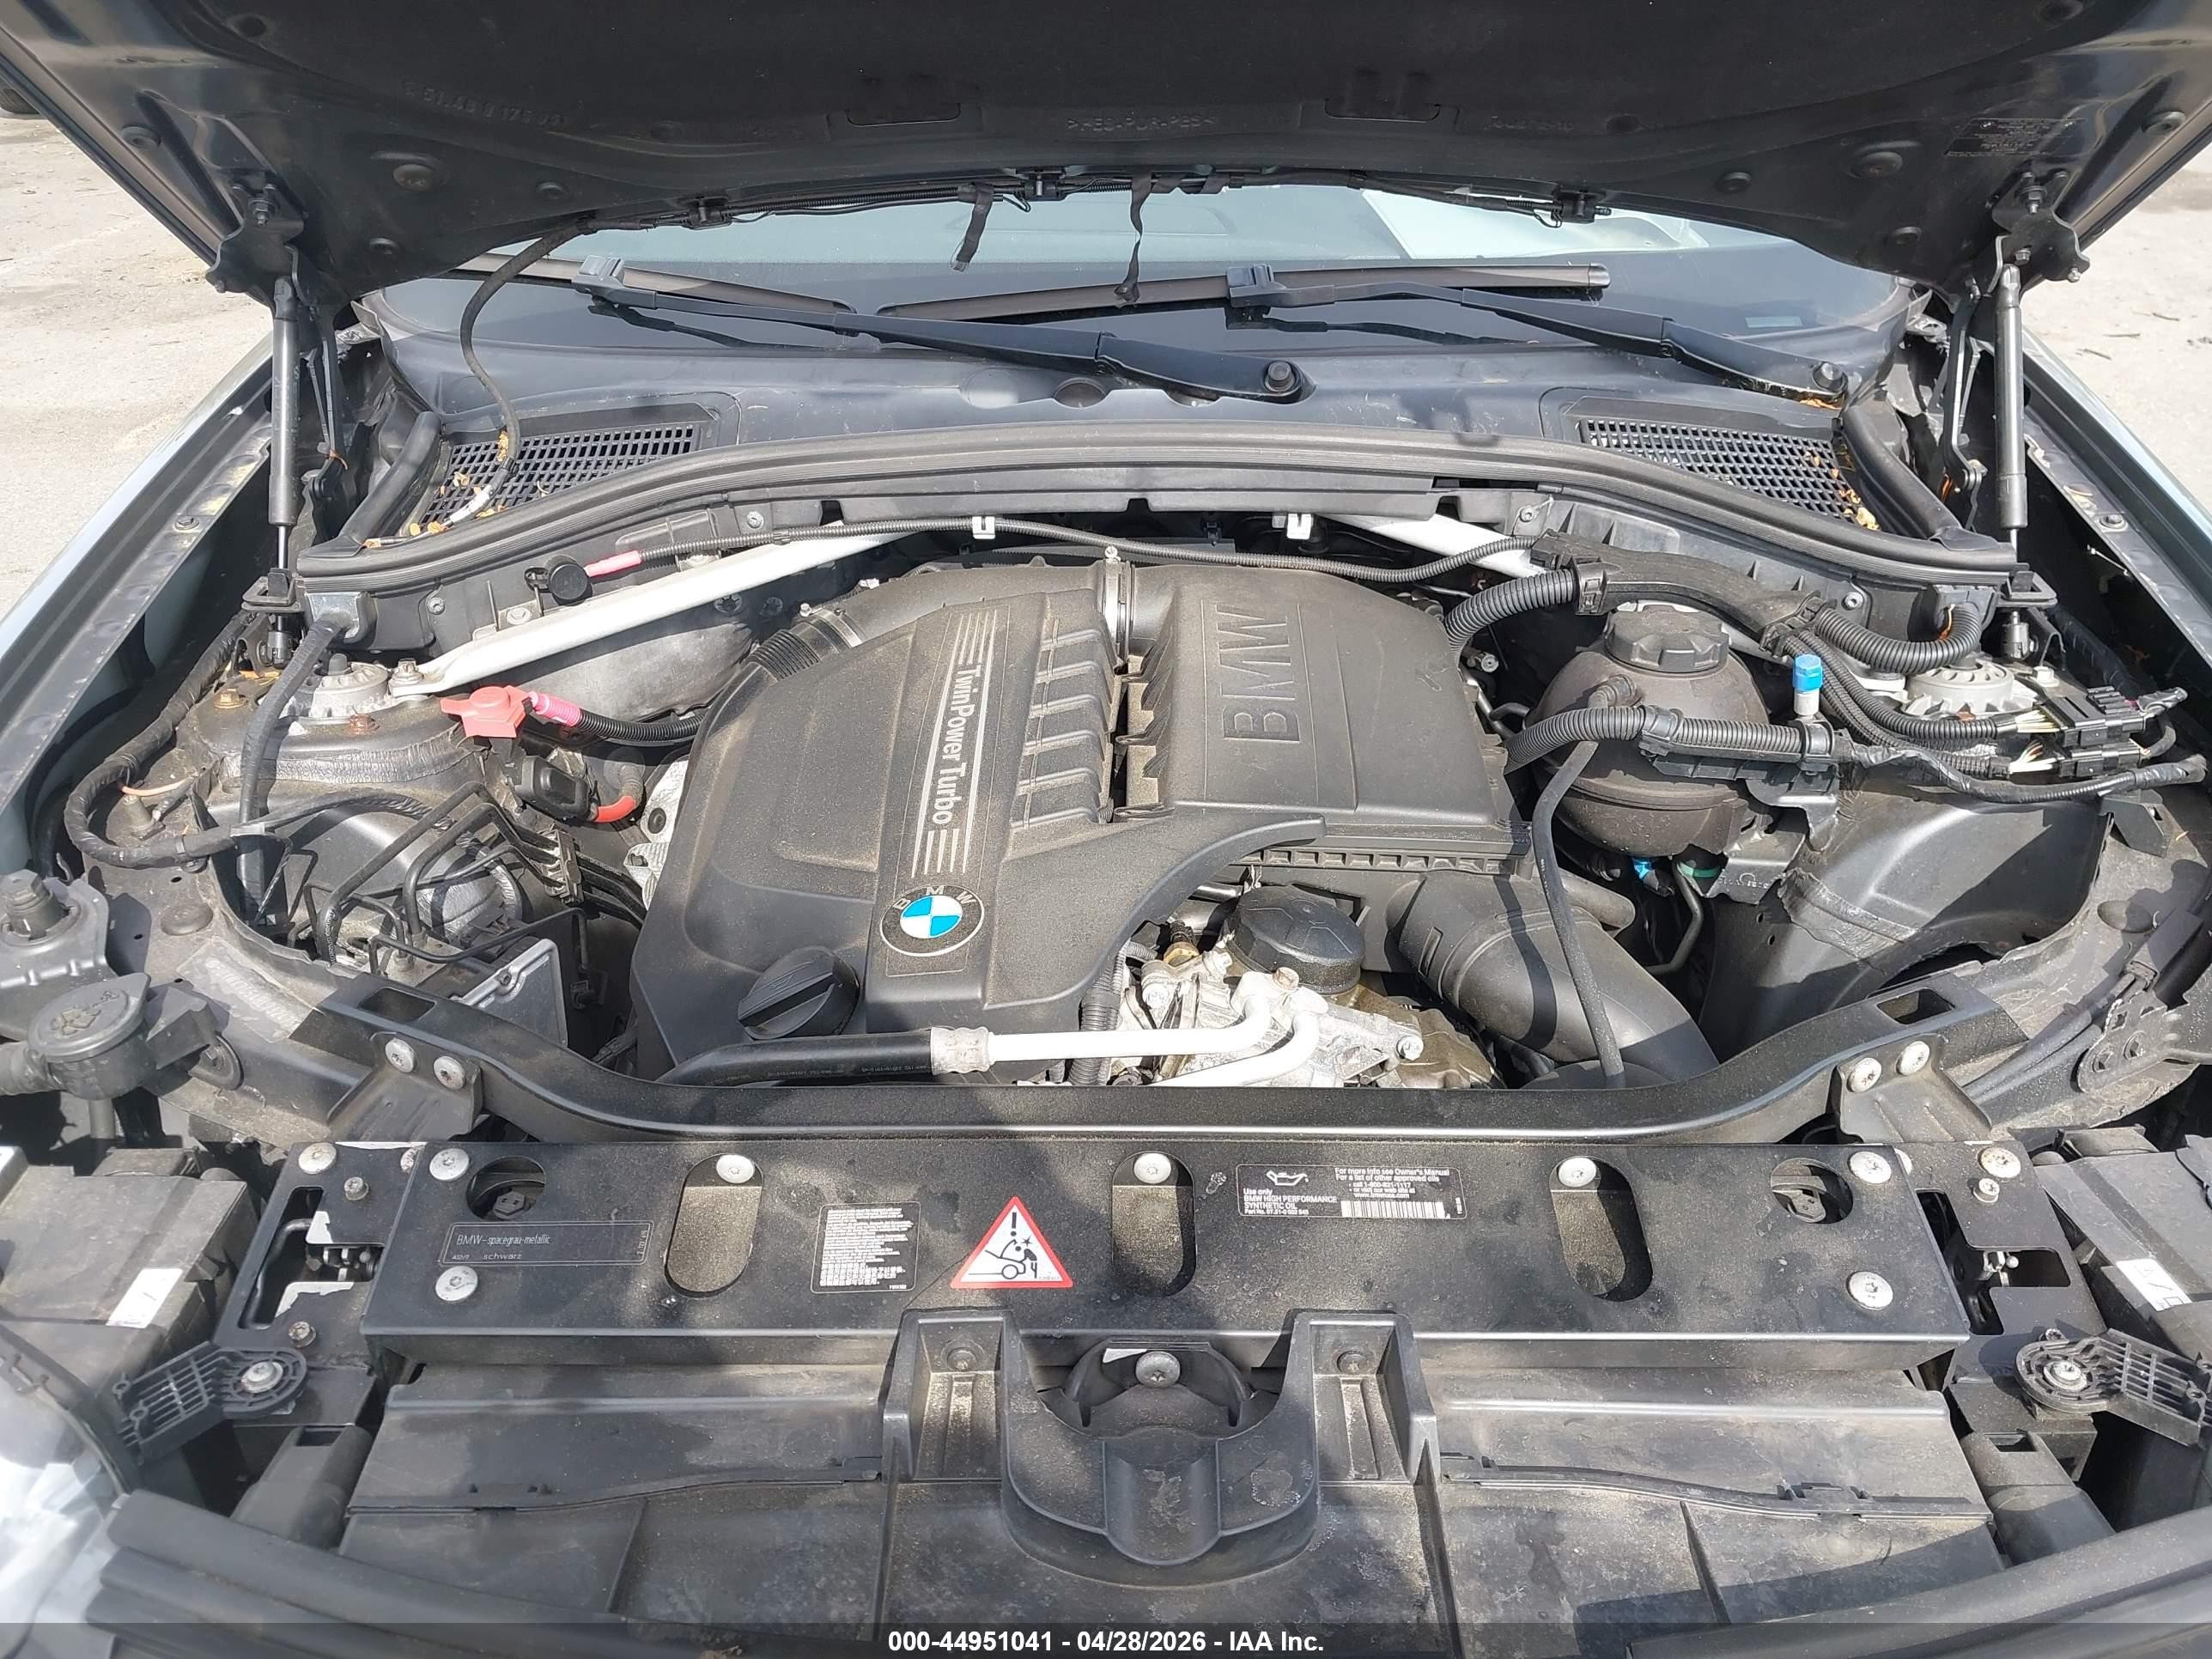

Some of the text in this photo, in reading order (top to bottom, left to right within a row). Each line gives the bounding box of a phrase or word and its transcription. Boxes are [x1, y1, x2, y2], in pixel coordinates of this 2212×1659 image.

[1214, 603, 1301, 745] BMW
[932, 664, 981, 825] TwinPower Turbo
[893, 885, 976, 911] BMW
[1257, 1188, 1273, 1197] only
